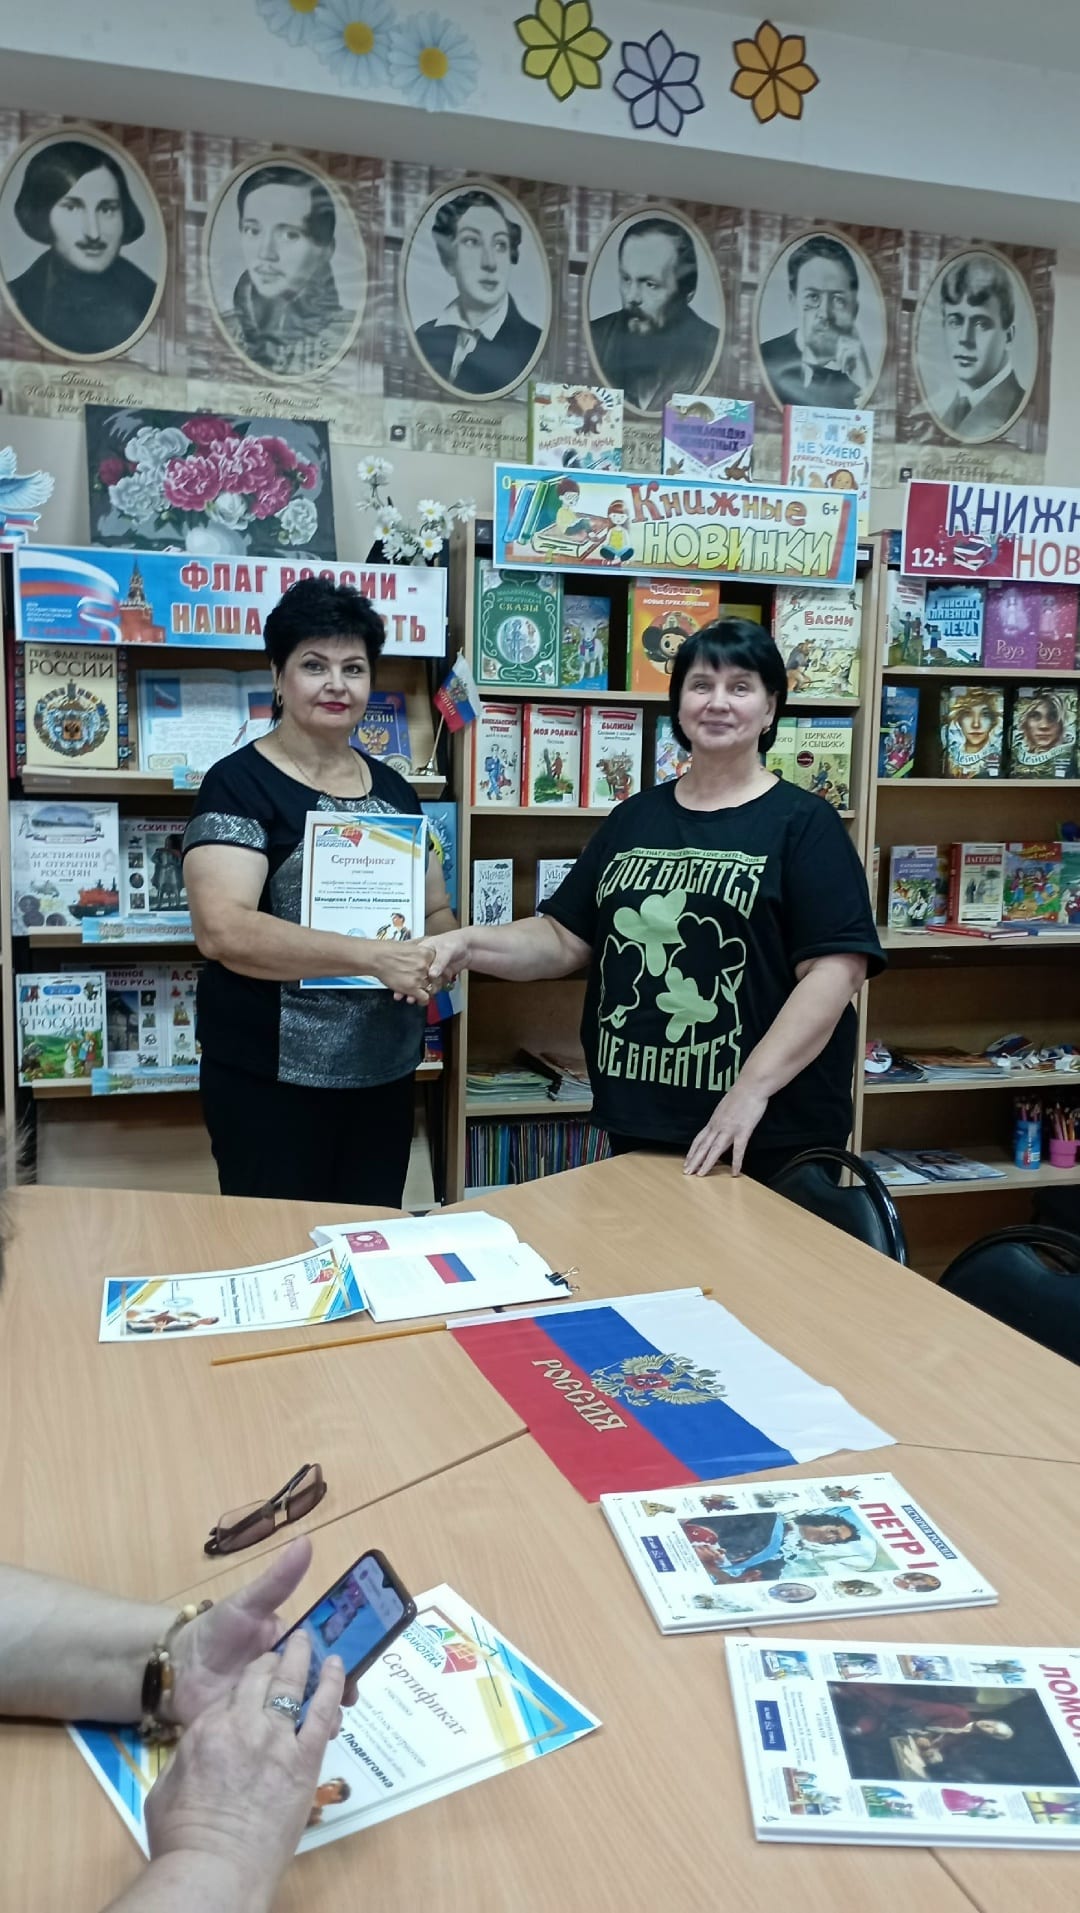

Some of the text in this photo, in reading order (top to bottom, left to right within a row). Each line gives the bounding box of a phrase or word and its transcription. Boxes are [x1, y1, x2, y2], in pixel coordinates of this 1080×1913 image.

[797, 441, 861, 461] НЕ УМЕЮ
[627, 482, 807, 527] Книжные
[822, 501, 840, 517] 6+
[643, 522, 832, 577] НОВИНКИ
[911, 547, 948, 568] 12+
[180, 562, 267, 593] ФЛАГ
[499, 603, 539, 612] СКАЗЫ
[172, 604, 262, 635] НАША
[28, 659, 114, 679] РОССИИ
[534, 728, 578, 738] МОЯ РОДИНА
[601, 722, 634, 731] БЫЛИНЫ
[805, 732, 841, 741] ЦИРКАЧИ
[809, 741, 845, 749] СЫЩИКИ
[331, 854, 396, 868] Сертификат
[130, 979, 155, 987] РУСИ
[32, 1016, 96, 1031] РОССИИ
[531, 1359, 628, 1432] РОССИЯ
[858, 1502, 926, 1555] ПЕТР
[403, 1631, 441, 1669] БЛИОТЕКА
[382, 1651, 467, 1737] Сертификат
[1039, 1663, 1080, 1748] ЛОМО
[341, 1730, 394, 1790] Людвиговна
